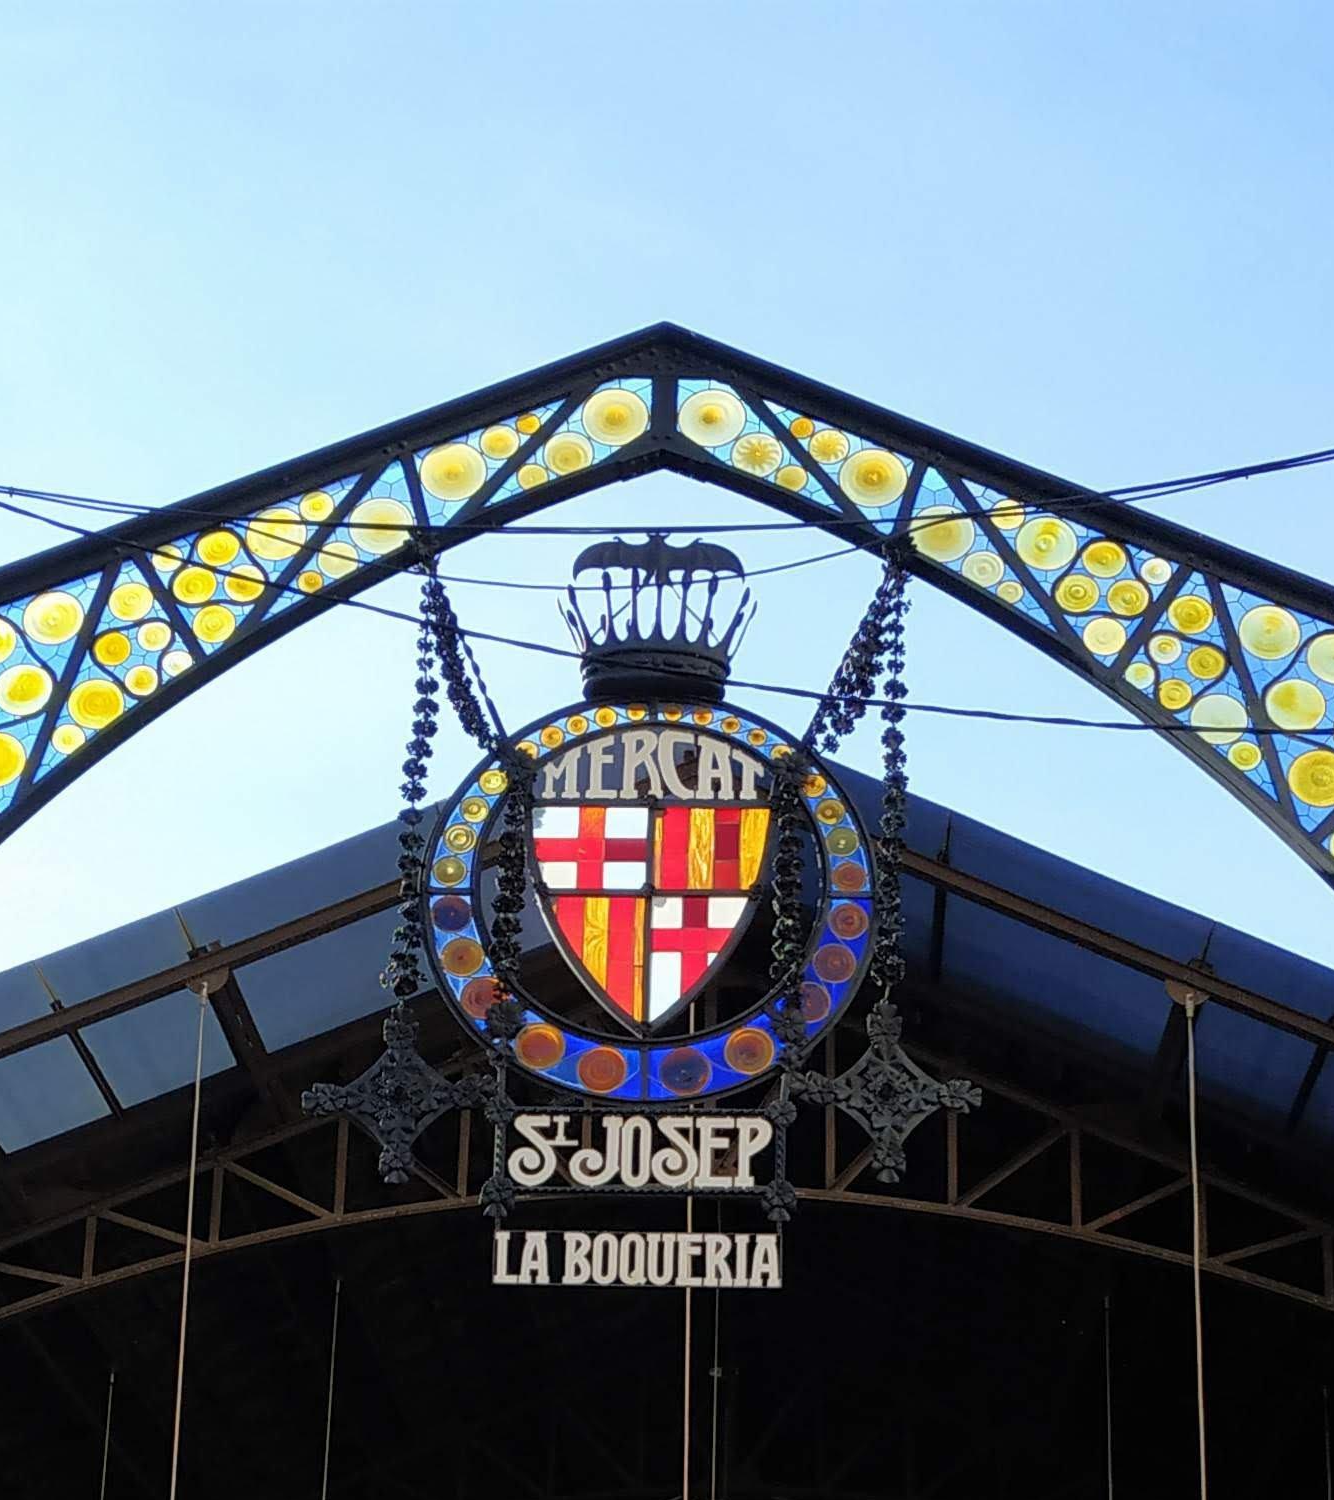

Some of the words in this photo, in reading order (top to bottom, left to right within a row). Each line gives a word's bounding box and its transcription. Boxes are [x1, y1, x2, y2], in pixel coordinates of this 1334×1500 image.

[540, 730, 765, 801] MERCAT
[569, 1114, 775, 1188] JOSEP
[493, 1231, 548, 1285] LA
[564, 1231, 782, 1288] BOQUERIA
